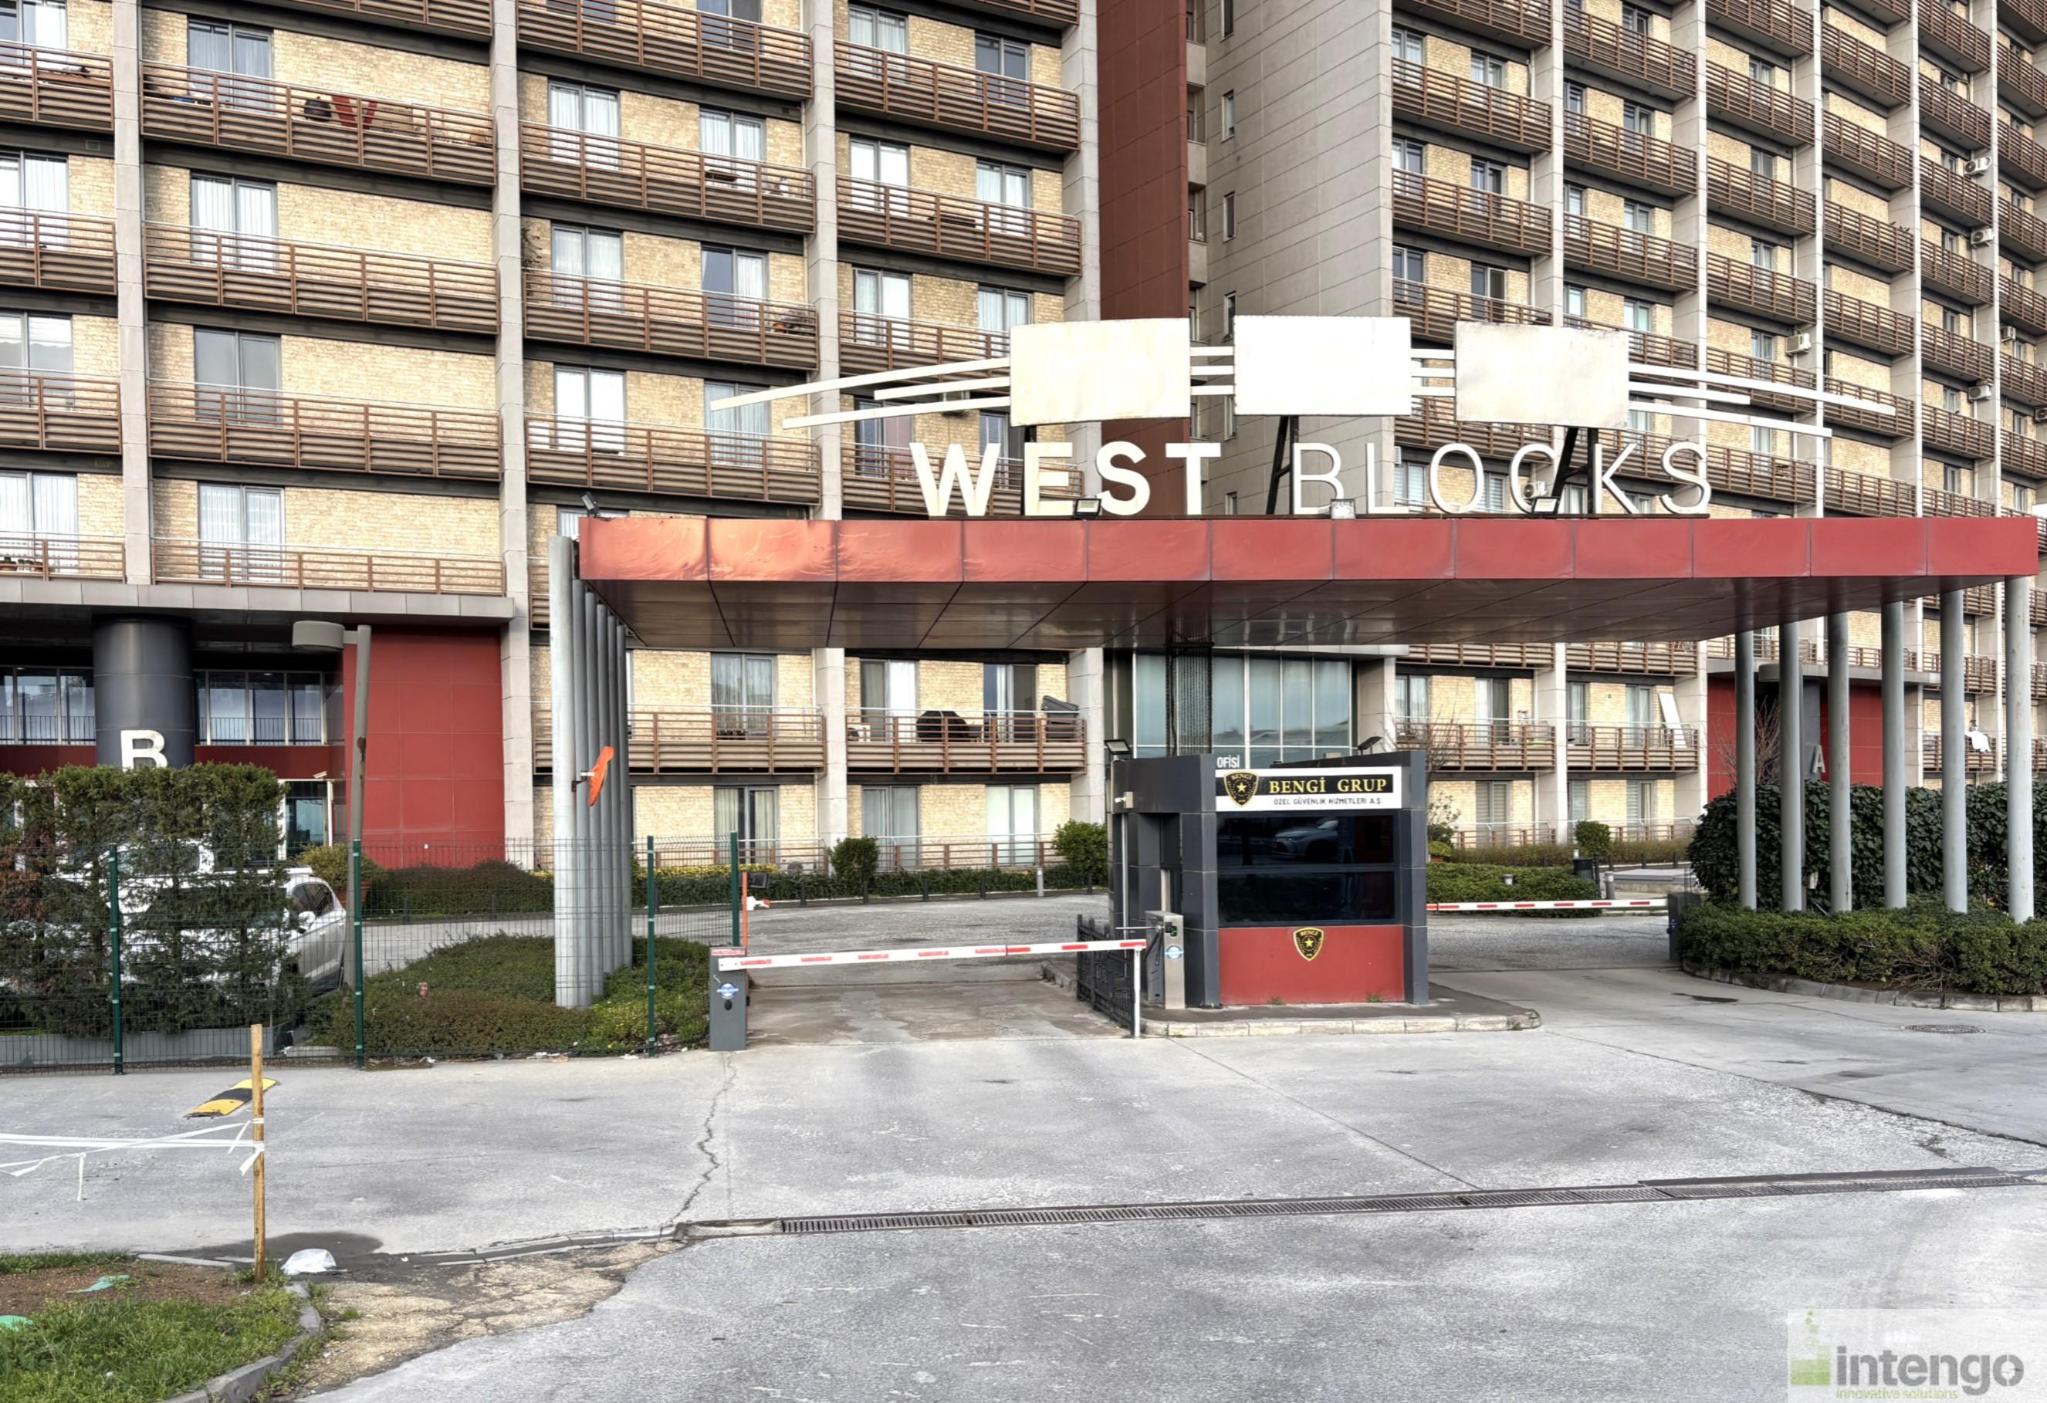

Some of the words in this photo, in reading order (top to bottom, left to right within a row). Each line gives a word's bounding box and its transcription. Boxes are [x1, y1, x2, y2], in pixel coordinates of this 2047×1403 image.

[909, 441, 1221, 516] WEST
[1292, 441, 1712, 516] BLOCKS
[1811, 745, 1826, 773] A
[1268, 777, 1326, 794] BENGİ
[1337, 778, 1387, 792] GRUP
